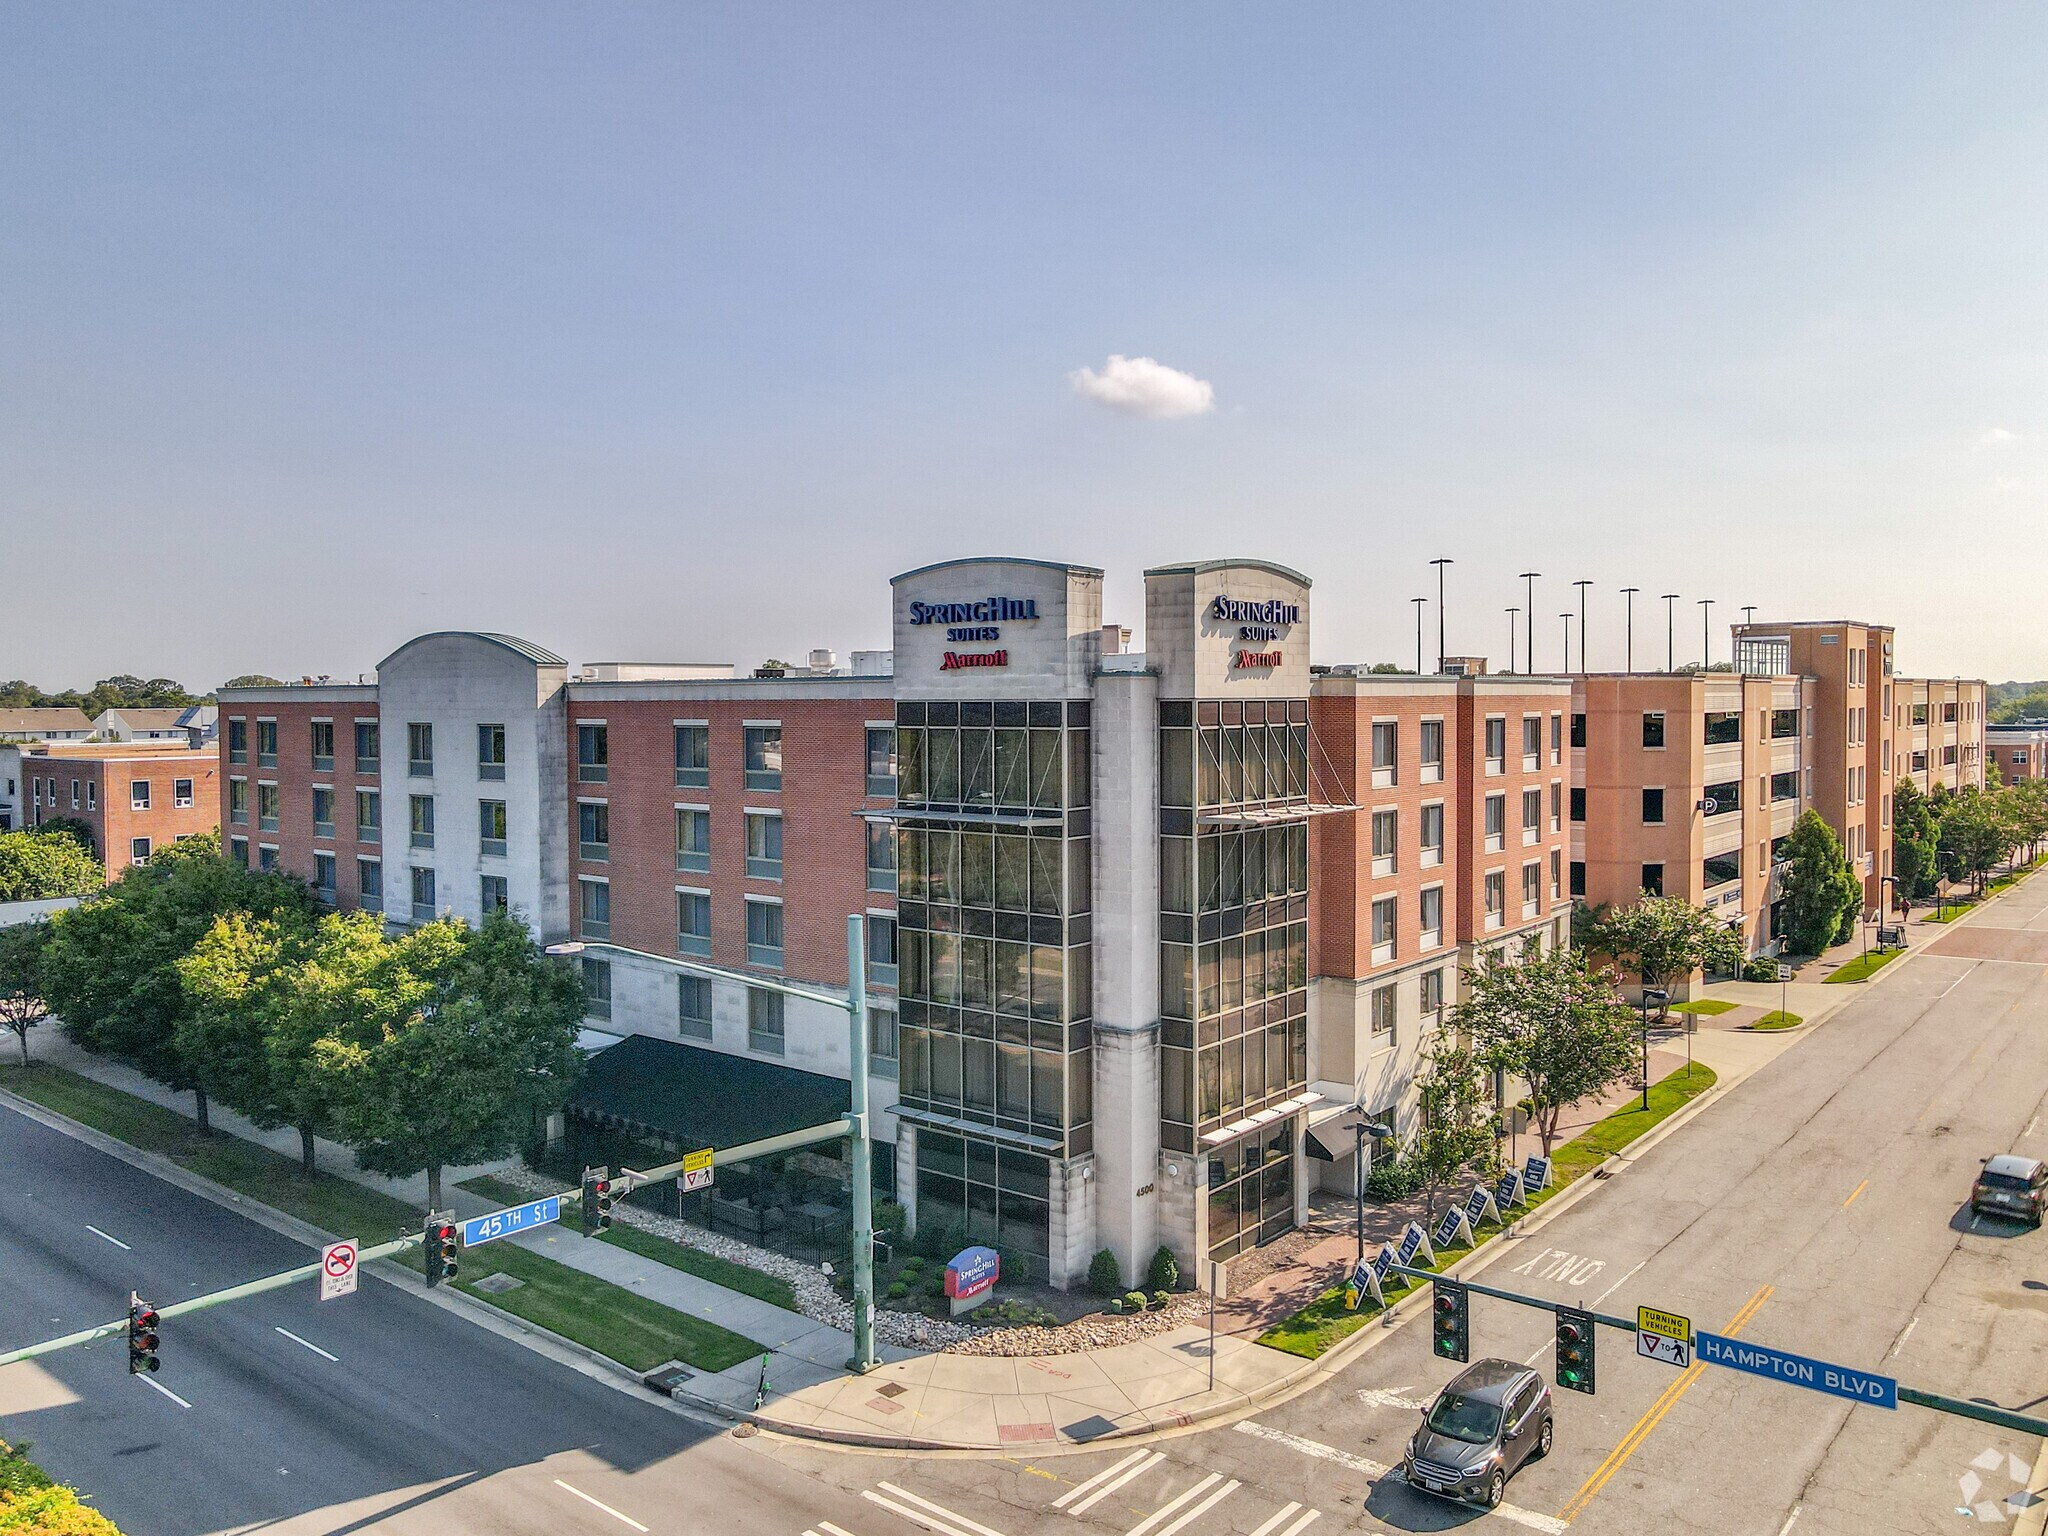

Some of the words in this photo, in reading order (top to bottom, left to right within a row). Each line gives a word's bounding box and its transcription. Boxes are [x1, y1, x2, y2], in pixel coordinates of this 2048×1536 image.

[947, 627, 999, 641] SUITES
[1240, 626, 1278, 640] SUITES
[940, 650, 1008, 670] Marriott
[1236, 650, 1283, 669] Marriott
[1136, 1183, 1154, 1197] 4500
[534, 1203, 548, 1222] St
[1510, 1247, 1606, 1286] ONLY
[1645, 1311, 1683, 1327] TURNING
[1645, 1321, 1682, 1336] VEHICLES
[1661, 1343, 1670, 1351] TO
[1706, 1340, 1813, 1381] HAMPTON
[1825, 1371, 1884, 1398] BLVD
